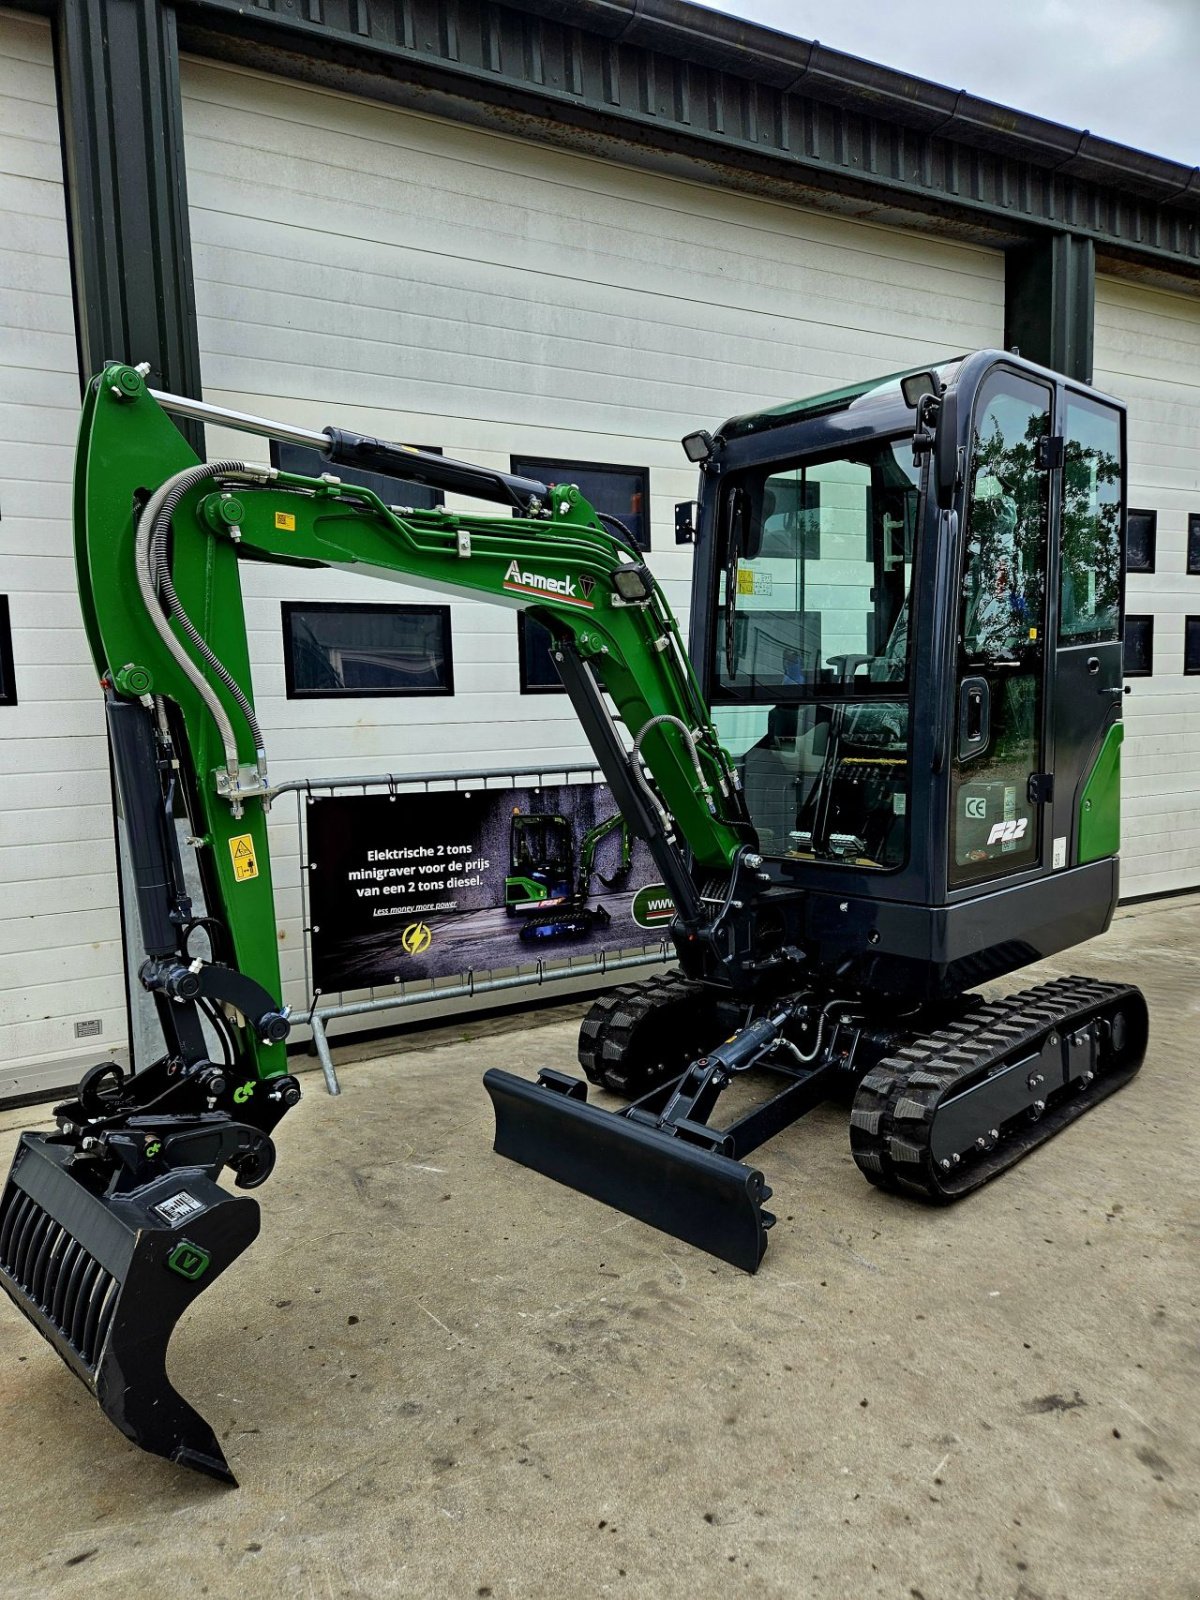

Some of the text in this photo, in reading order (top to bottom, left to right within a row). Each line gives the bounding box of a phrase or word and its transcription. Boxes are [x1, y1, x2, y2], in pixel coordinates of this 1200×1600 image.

[967, 800, 985, 817] CE
[987, 818, 1028, 845] F22
[367, 845, 472, 861] Elektrische 2 tons
[348, 858, 490, 881] minigraver voor de prijs
[356, 875, 483, 897] van een 2 tons diesel.
[373, 901, 457, 917] Less money more power
